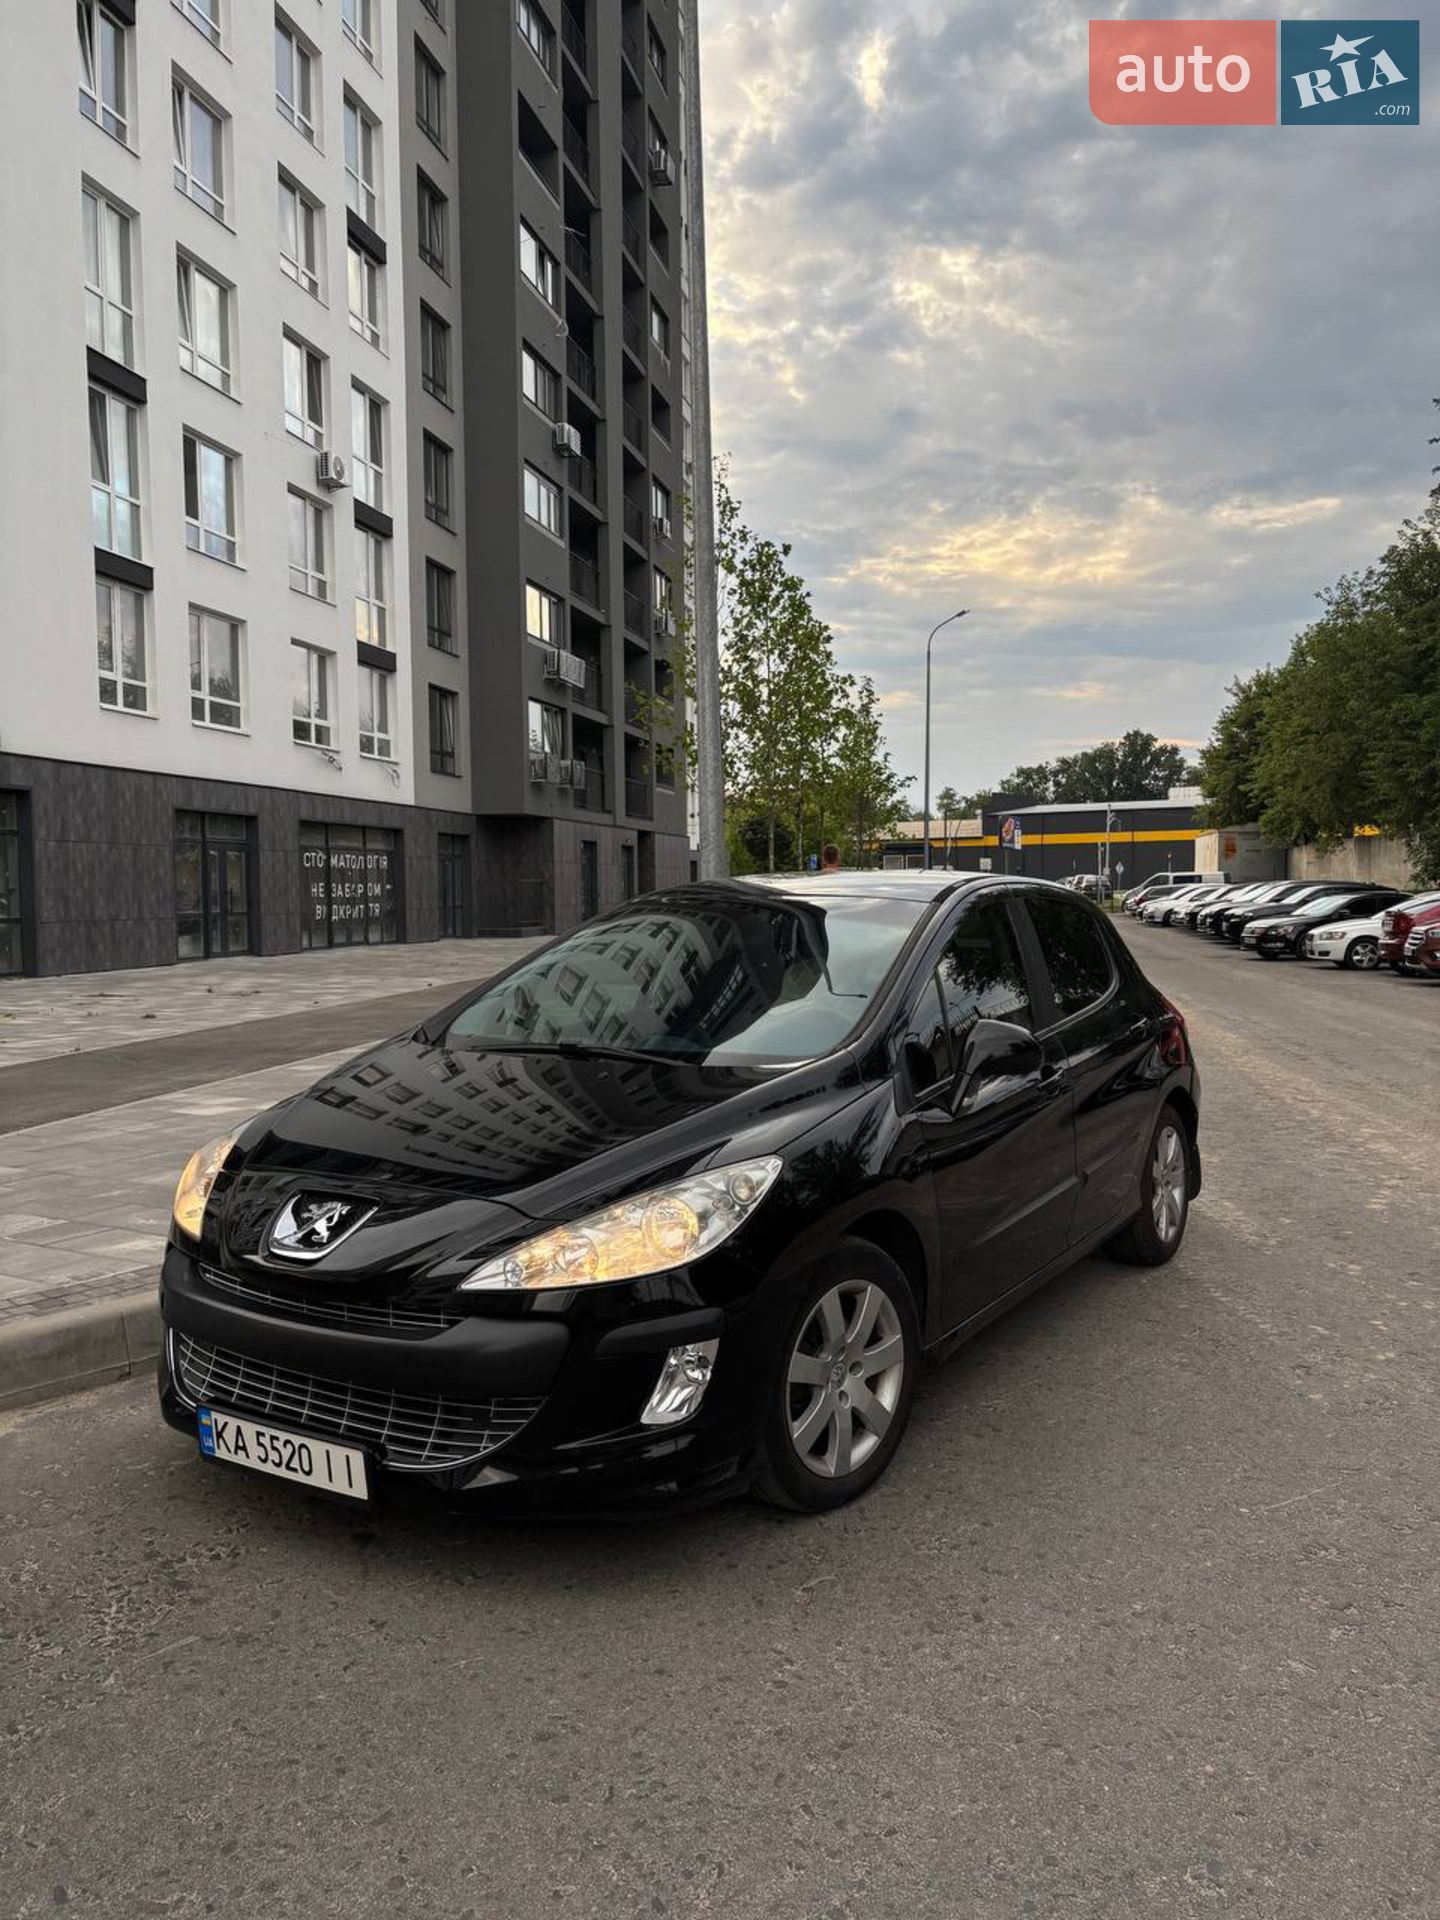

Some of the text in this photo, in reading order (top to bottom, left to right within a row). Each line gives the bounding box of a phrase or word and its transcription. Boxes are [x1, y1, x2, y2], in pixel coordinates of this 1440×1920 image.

[214, 1417, 353, 1489] KA 5520 II
